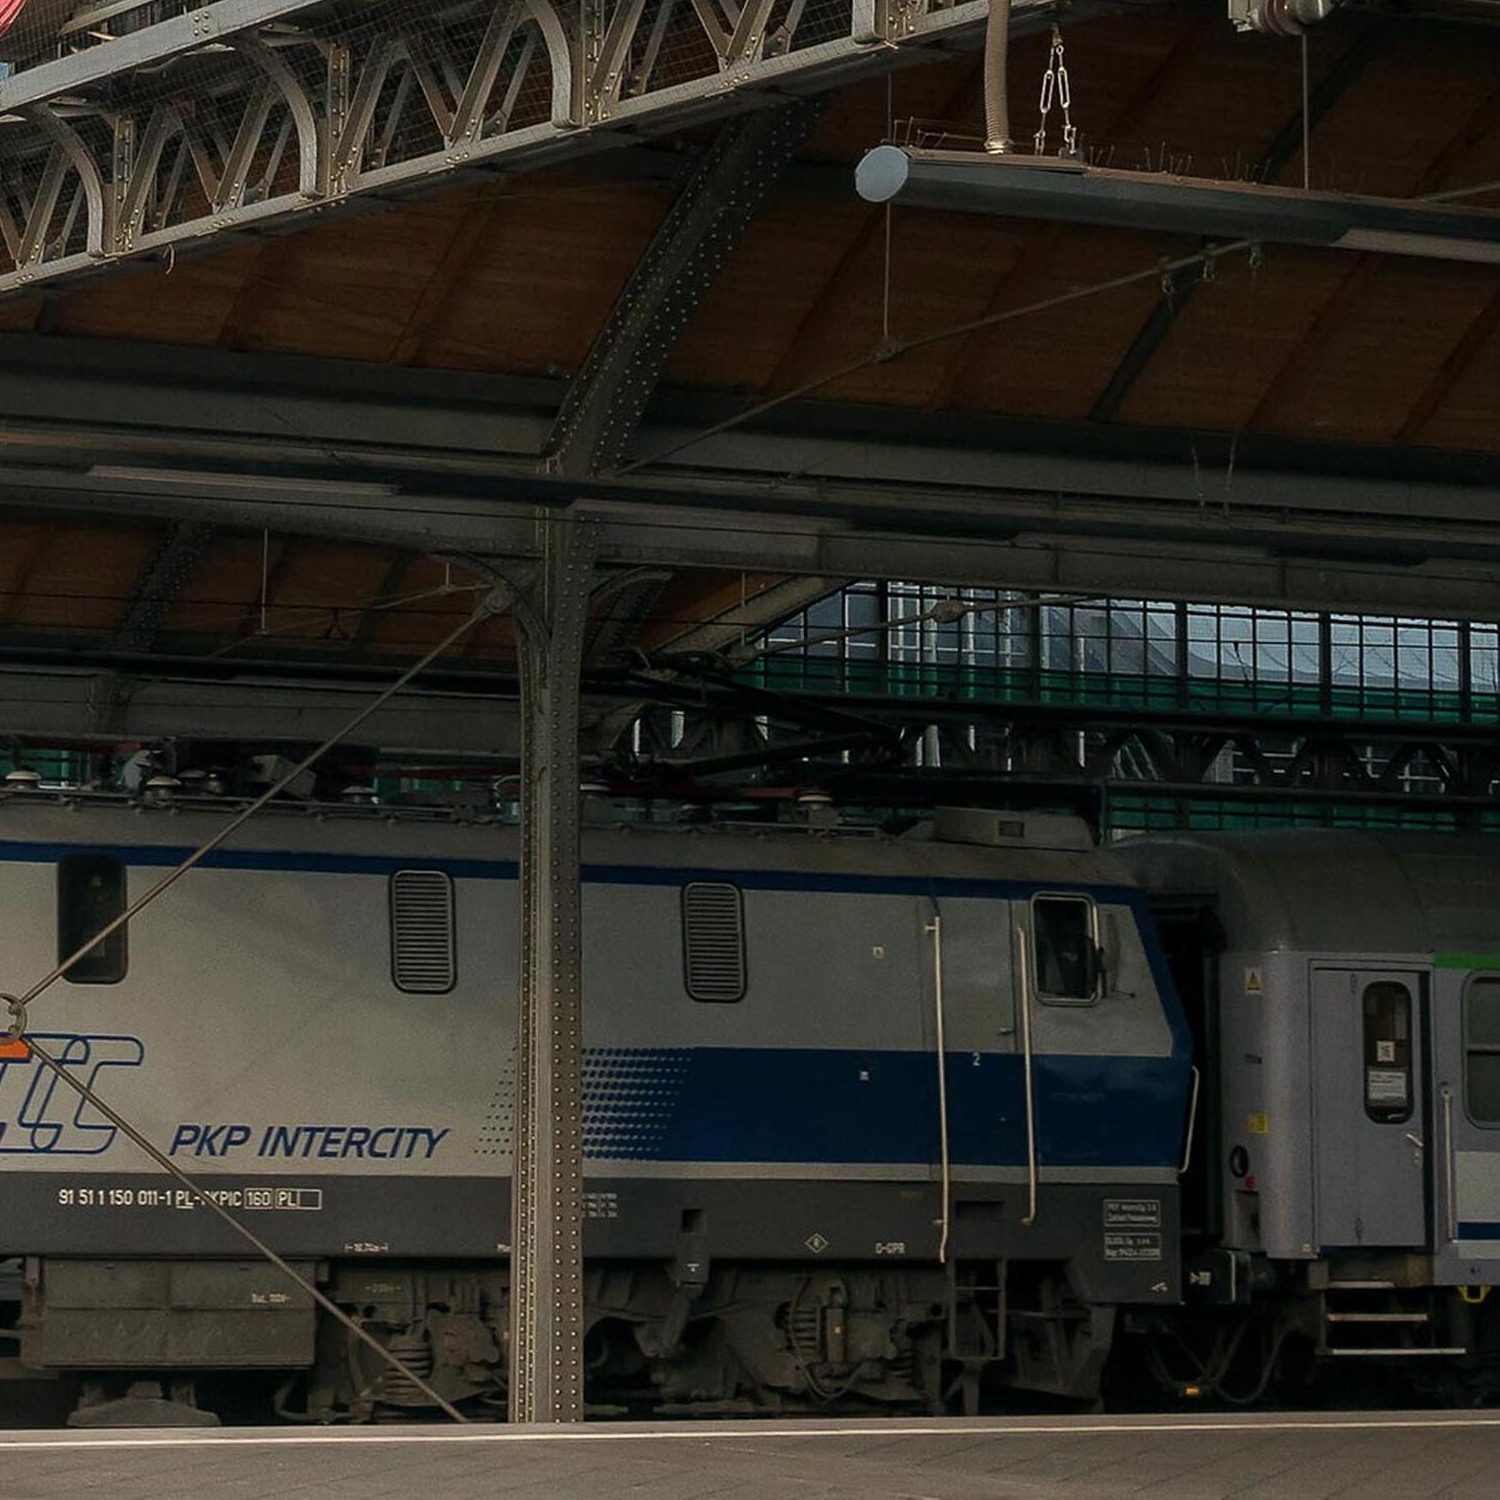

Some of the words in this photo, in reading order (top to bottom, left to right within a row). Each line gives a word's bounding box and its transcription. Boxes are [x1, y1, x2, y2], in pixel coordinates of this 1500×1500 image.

[972, 1052, 981, 1067] 2
[169, 1124, 251, 1156] PKP
[257, 1126, 450, 1158] INTERCITY
[58, 1189, 74, 1205] 91
[79, 1189, 94, 1205] 51
[109, 1190, 133, 1205] 150
[137, 1190, 171, 1206] 011-1
[247, 1191, 271, 1206] 160
[279, 1191, 297, 1207] PL
